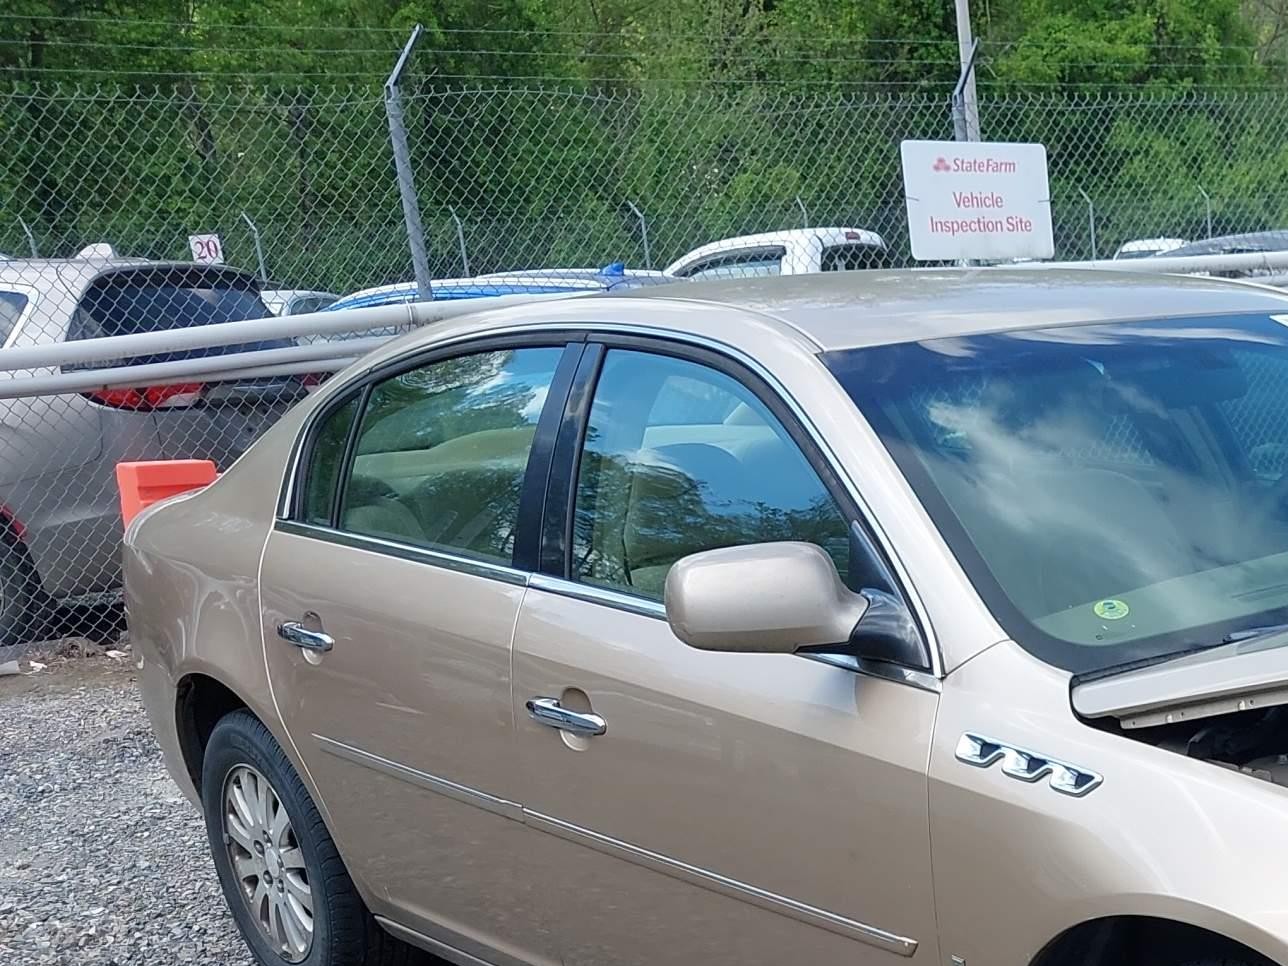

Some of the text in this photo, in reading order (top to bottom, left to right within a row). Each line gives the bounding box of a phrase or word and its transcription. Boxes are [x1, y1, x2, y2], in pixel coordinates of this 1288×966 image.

[953, 191, 1004, 209] Vehicle
[930, 215, 1032, 237] Inspection Site
[194, 239, 218, 260] 20
